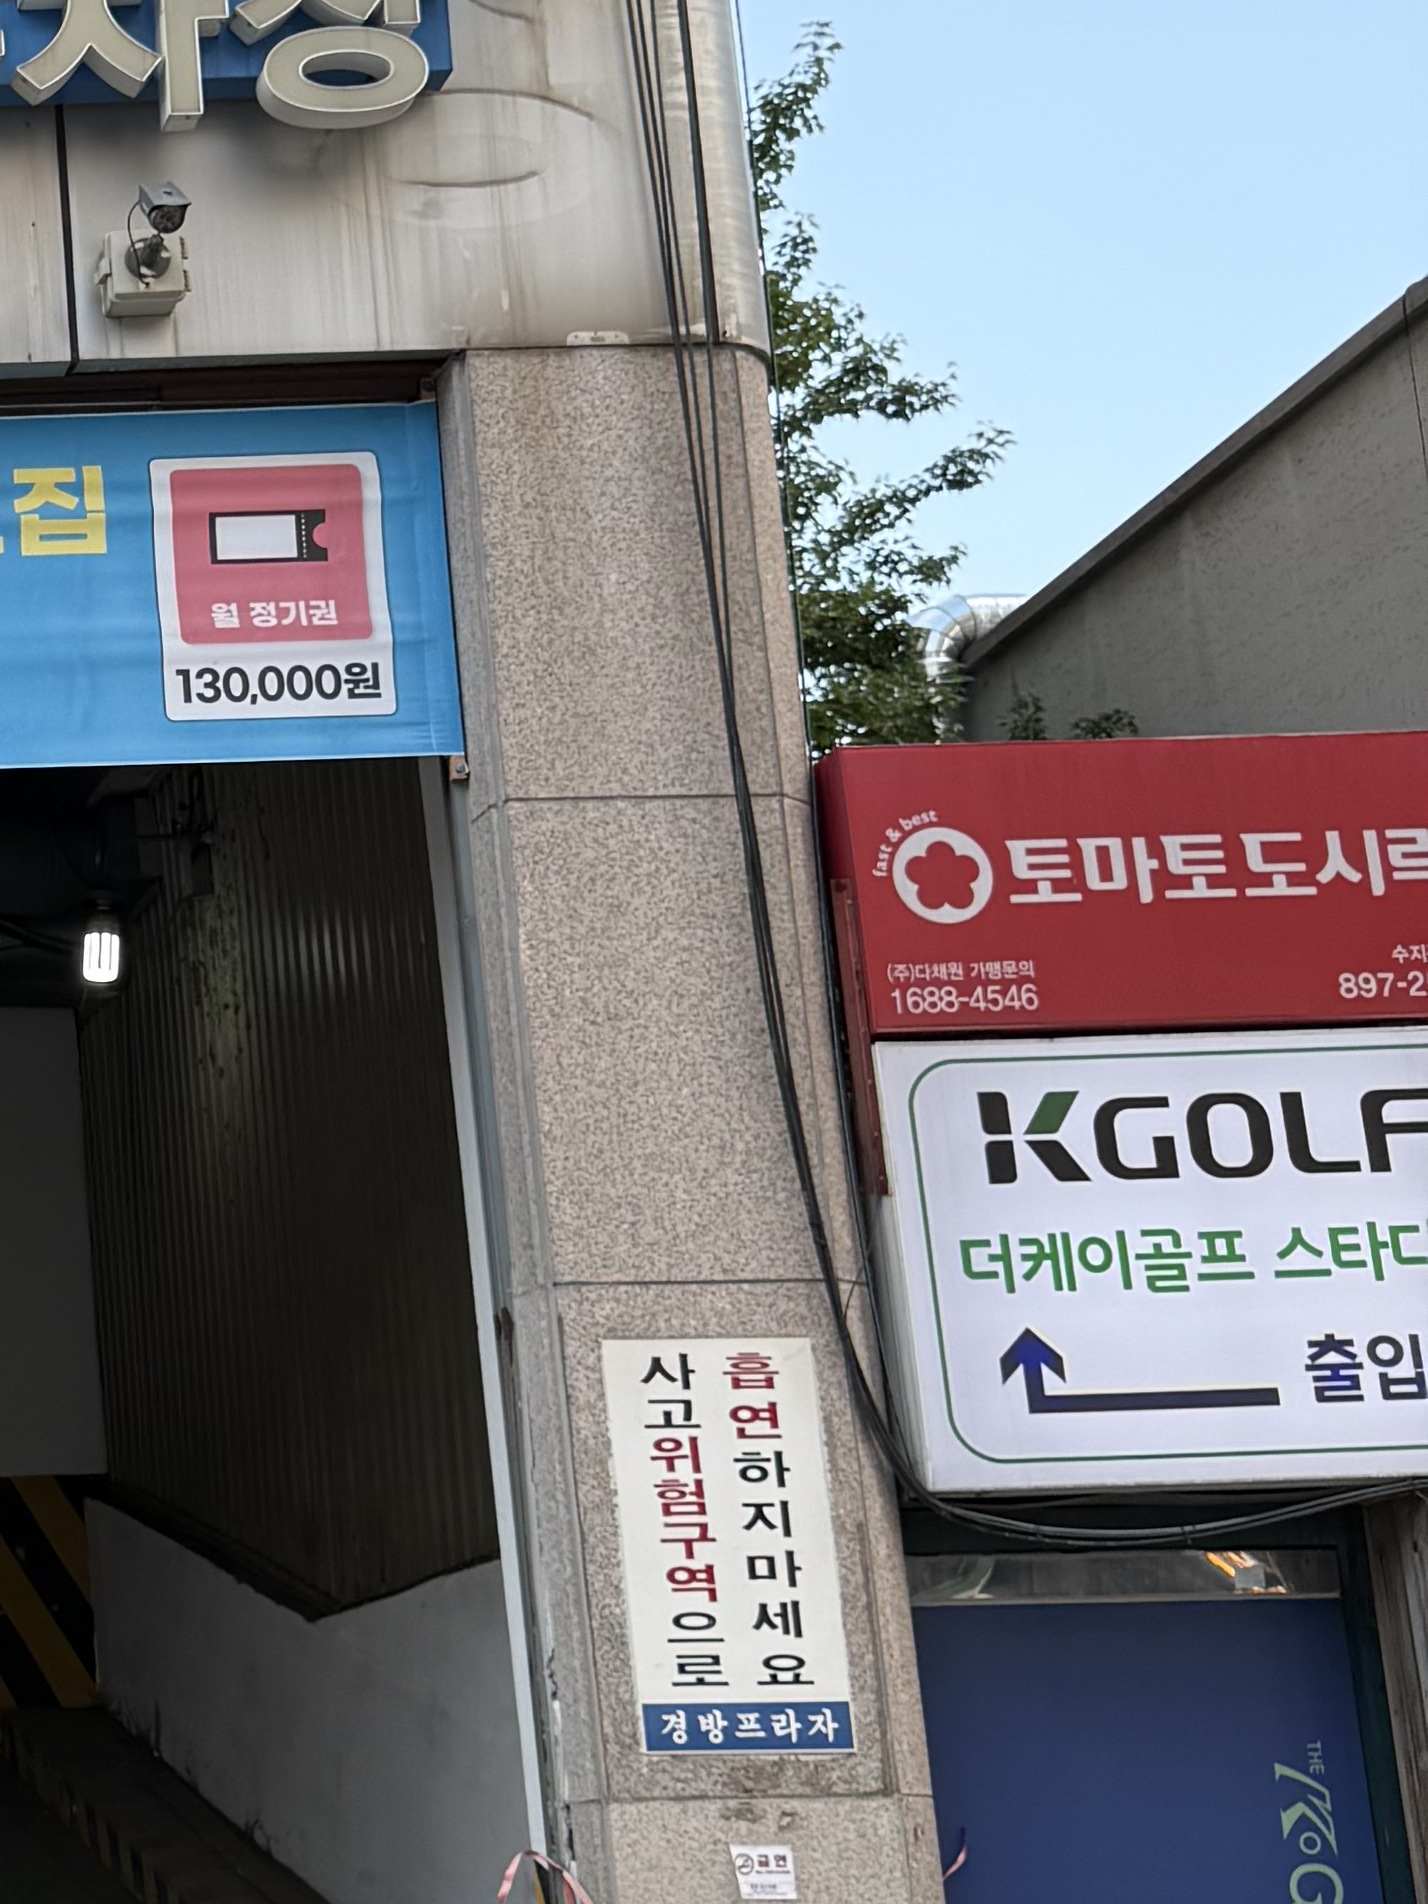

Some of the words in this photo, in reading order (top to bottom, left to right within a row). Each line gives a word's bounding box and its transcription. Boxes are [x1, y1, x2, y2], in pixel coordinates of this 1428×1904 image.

[211, 602, 240, 628] 월
[249, 599, 338, 627] 정기권
[175, 662, 382, 704] 130,000원
[872, 844, 893, 877] fast
[899, 810, 938, 830] best
[891, 983, 1039, 1014] 1688-4546
[1339, 970, 1428, 998] 897-2
[960, 1226, 1255, 1295] 더케이골프
[640, 1353, 730, 1688] 사고위험구역으로
[722, 1351, 815, 1686] 흡연하지마세요
[660, 1707, 840, 1745] 경방프라자
[1307, 1740, 1325, 1775] THE
